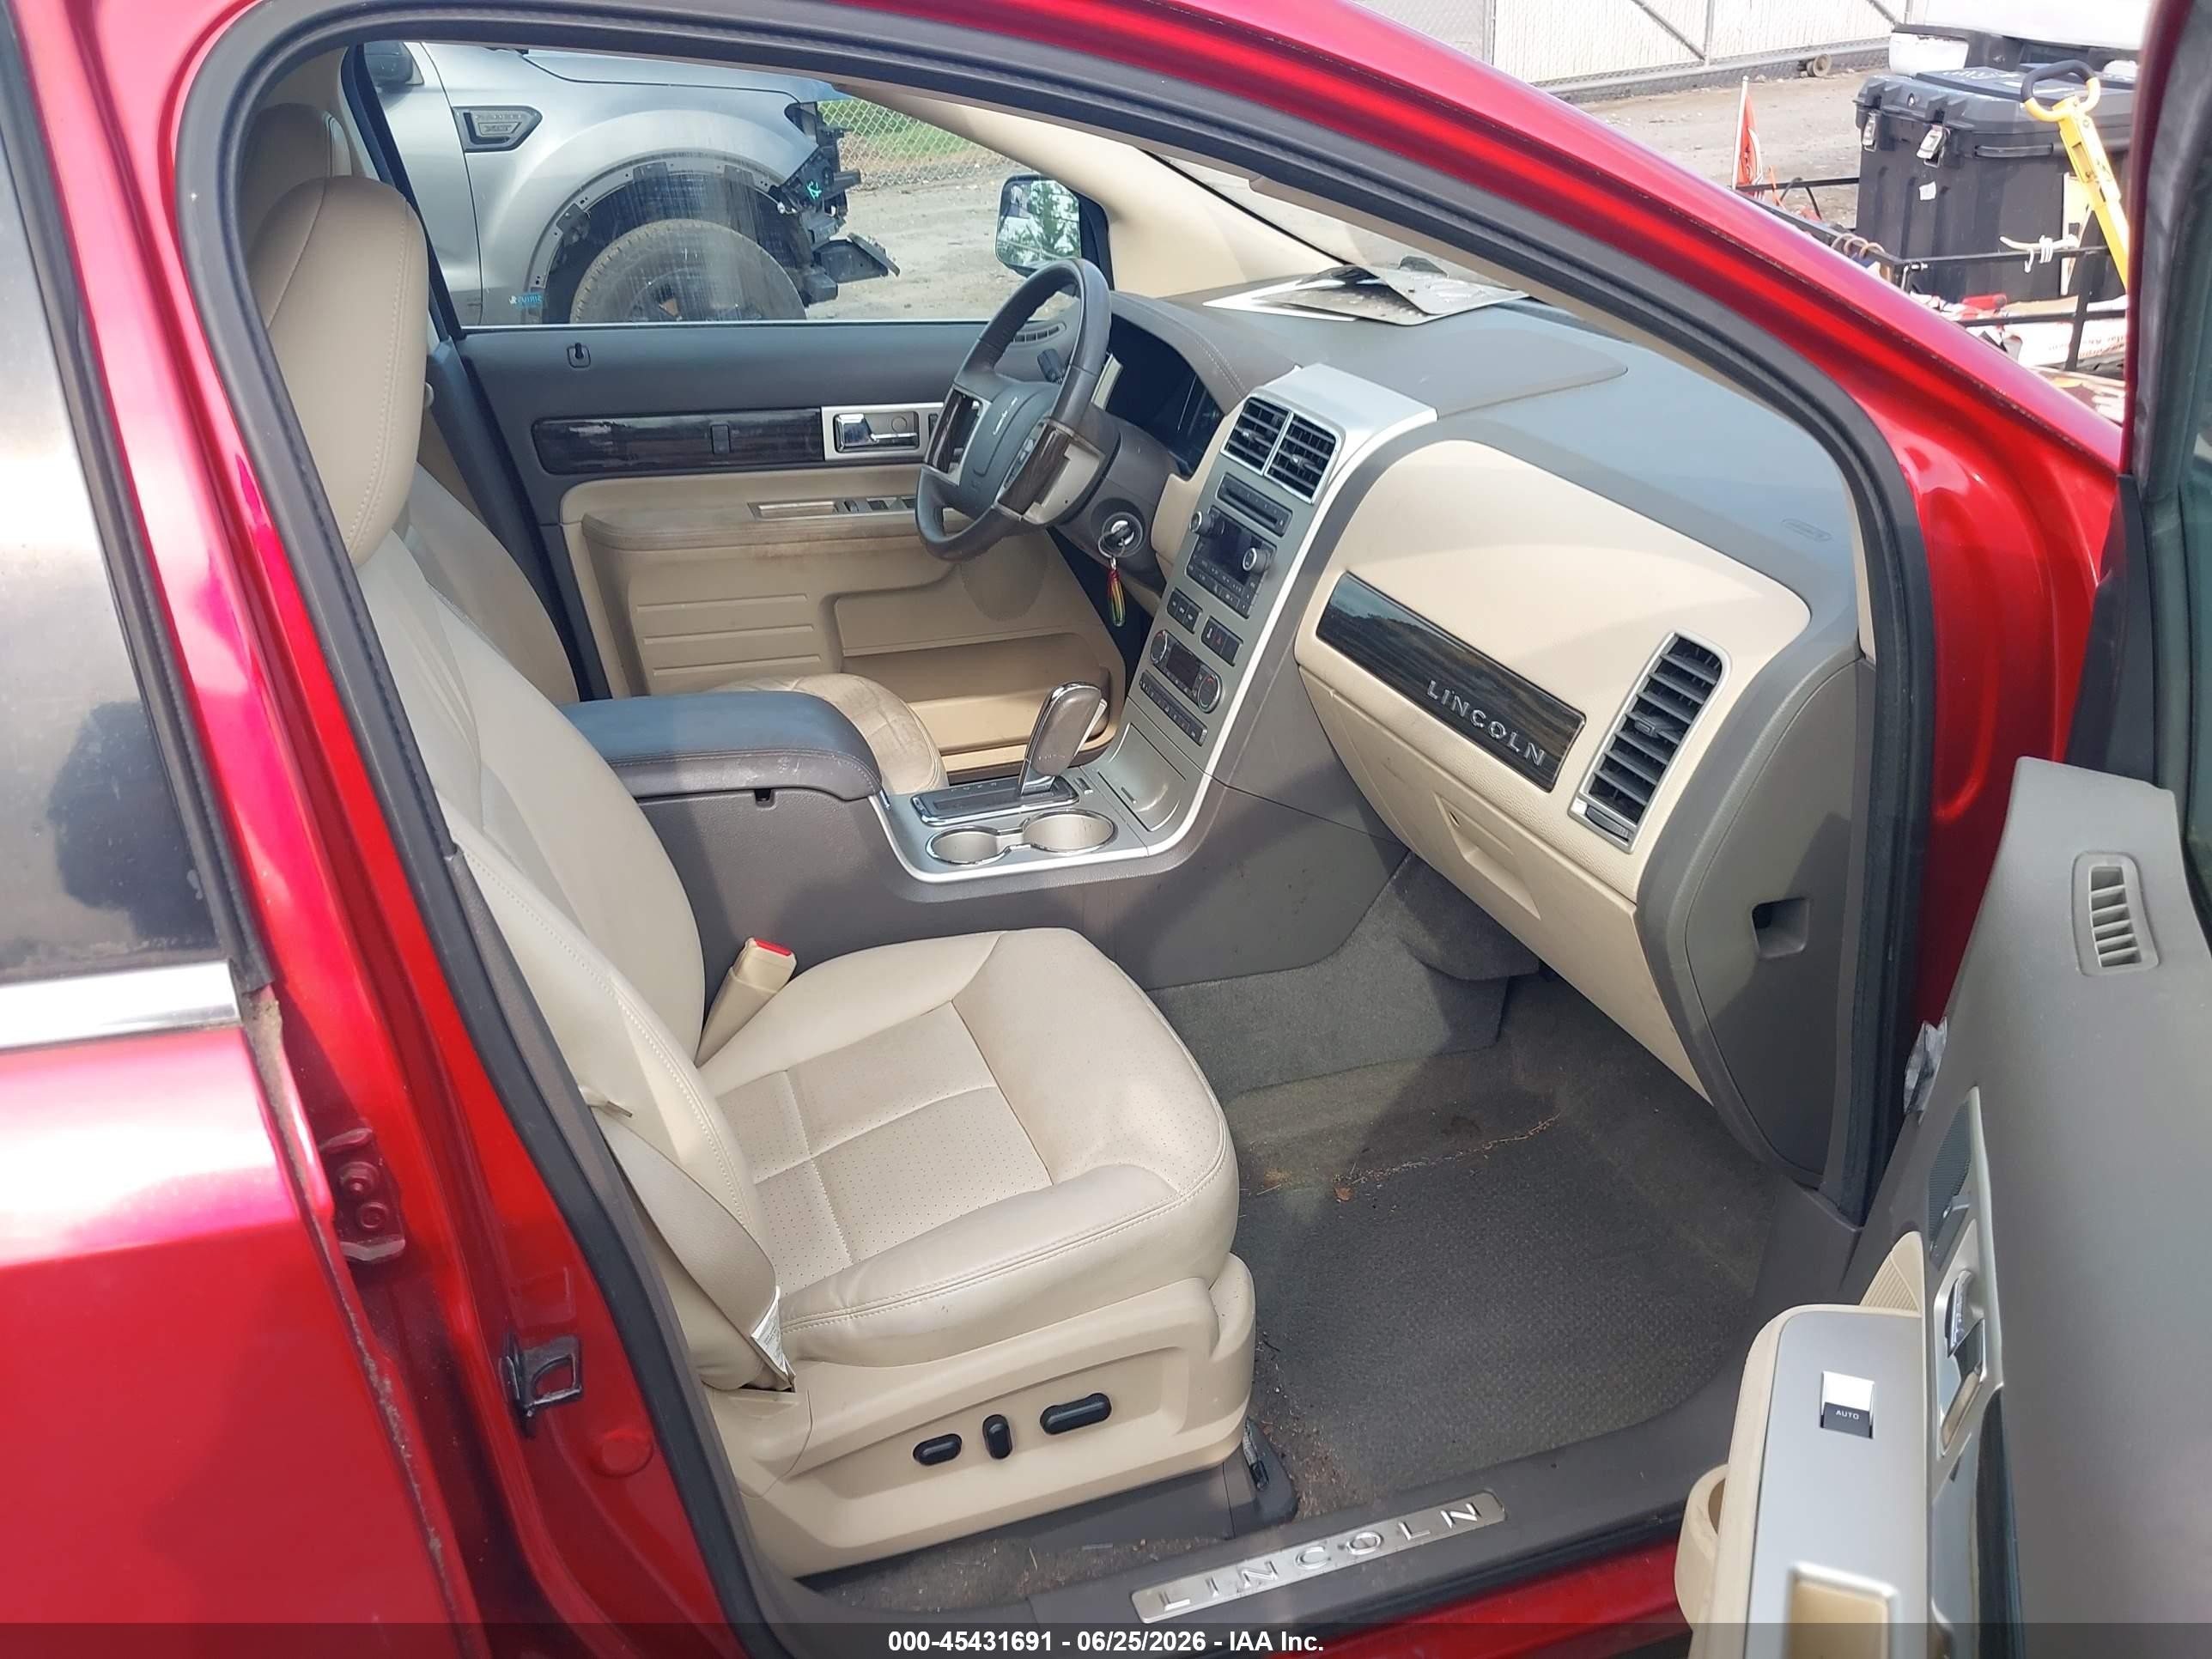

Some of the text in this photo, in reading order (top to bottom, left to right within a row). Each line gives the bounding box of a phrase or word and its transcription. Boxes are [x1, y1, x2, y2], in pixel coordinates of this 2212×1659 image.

[1426, 679, 1546, 767] LINCOLN
[1835, 1409, 1860, 1420] AUTO
[1159, 1502, 1481, 1613] LINCOLN
